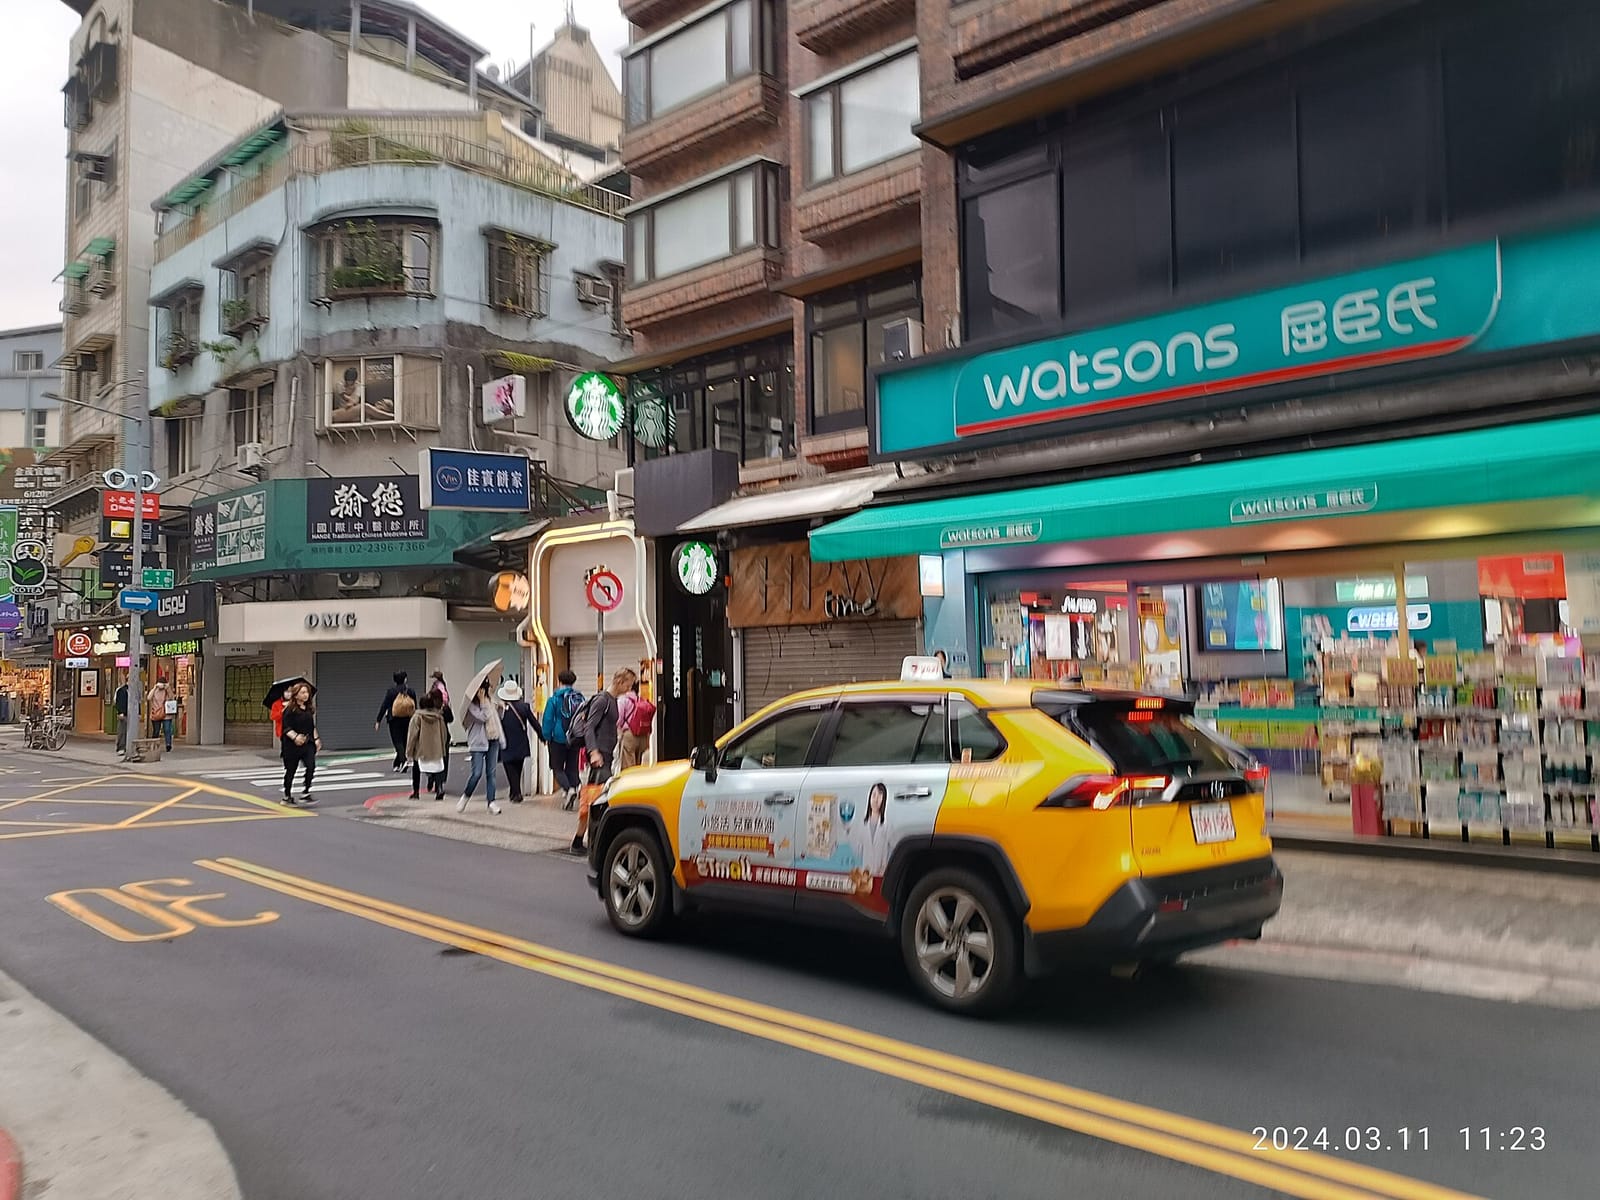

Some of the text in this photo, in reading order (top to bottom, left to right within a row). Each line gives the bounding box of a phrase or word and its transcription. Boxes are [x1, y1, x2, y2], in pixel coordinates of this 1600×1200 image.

[983, 276, 1439, 411] watsons 屈臣氏
[330, 482, 404, 518] 翰德
[1241, 495, 1317, 516] watsons
[304, 612, 357, 630] OMG
